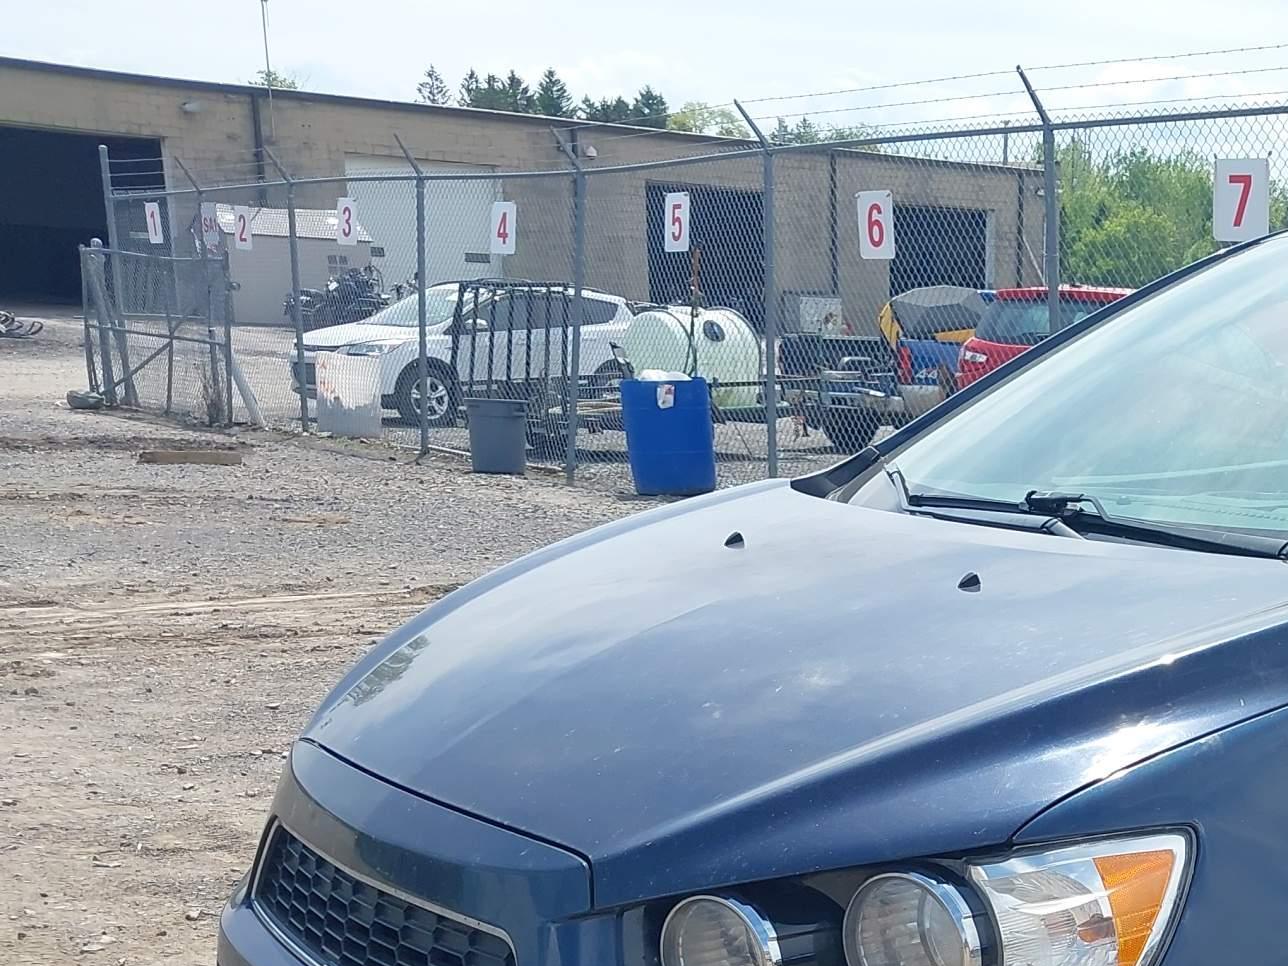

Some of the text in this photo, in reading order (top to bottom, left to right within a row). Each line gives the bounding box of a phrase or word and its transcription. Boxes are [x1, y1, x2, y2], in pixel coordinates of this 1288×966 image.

[1229, 175, 1252, 227] 7
[150, 211, 158, 238] 1
[238, 215, 248, 242] 2
[342, 206, 352, 237] 3
[497, 212, 509, 244] 4
[672, 204, 683, 241] 5
[867, 203, 884, 248] 6
